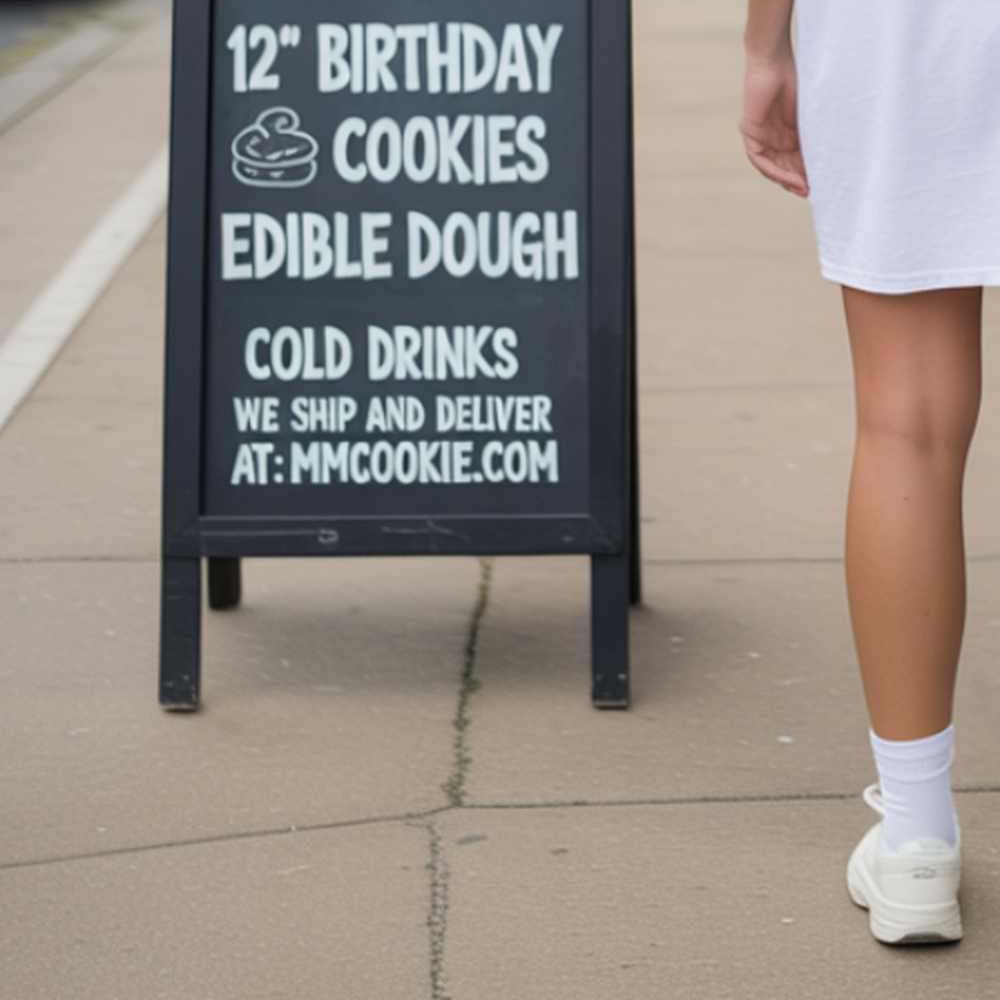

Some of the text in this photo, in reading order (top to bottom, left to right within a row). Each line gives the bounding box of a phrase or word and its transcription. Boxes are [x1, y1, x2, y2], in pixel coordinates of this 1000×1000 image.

[317, 22, 563, 93] BIRTHDAY
[333, 115, 548, 185] COOKIES
[222, 210, 578, 280] EDIBLE DOUGH
[246, 326, 518, 380] COLD DRINKS
[234, 395, 552, 432] WE SHIP AND DELIVER
[232, 440, 558, 484] AT: MMCOOKIE.COM
